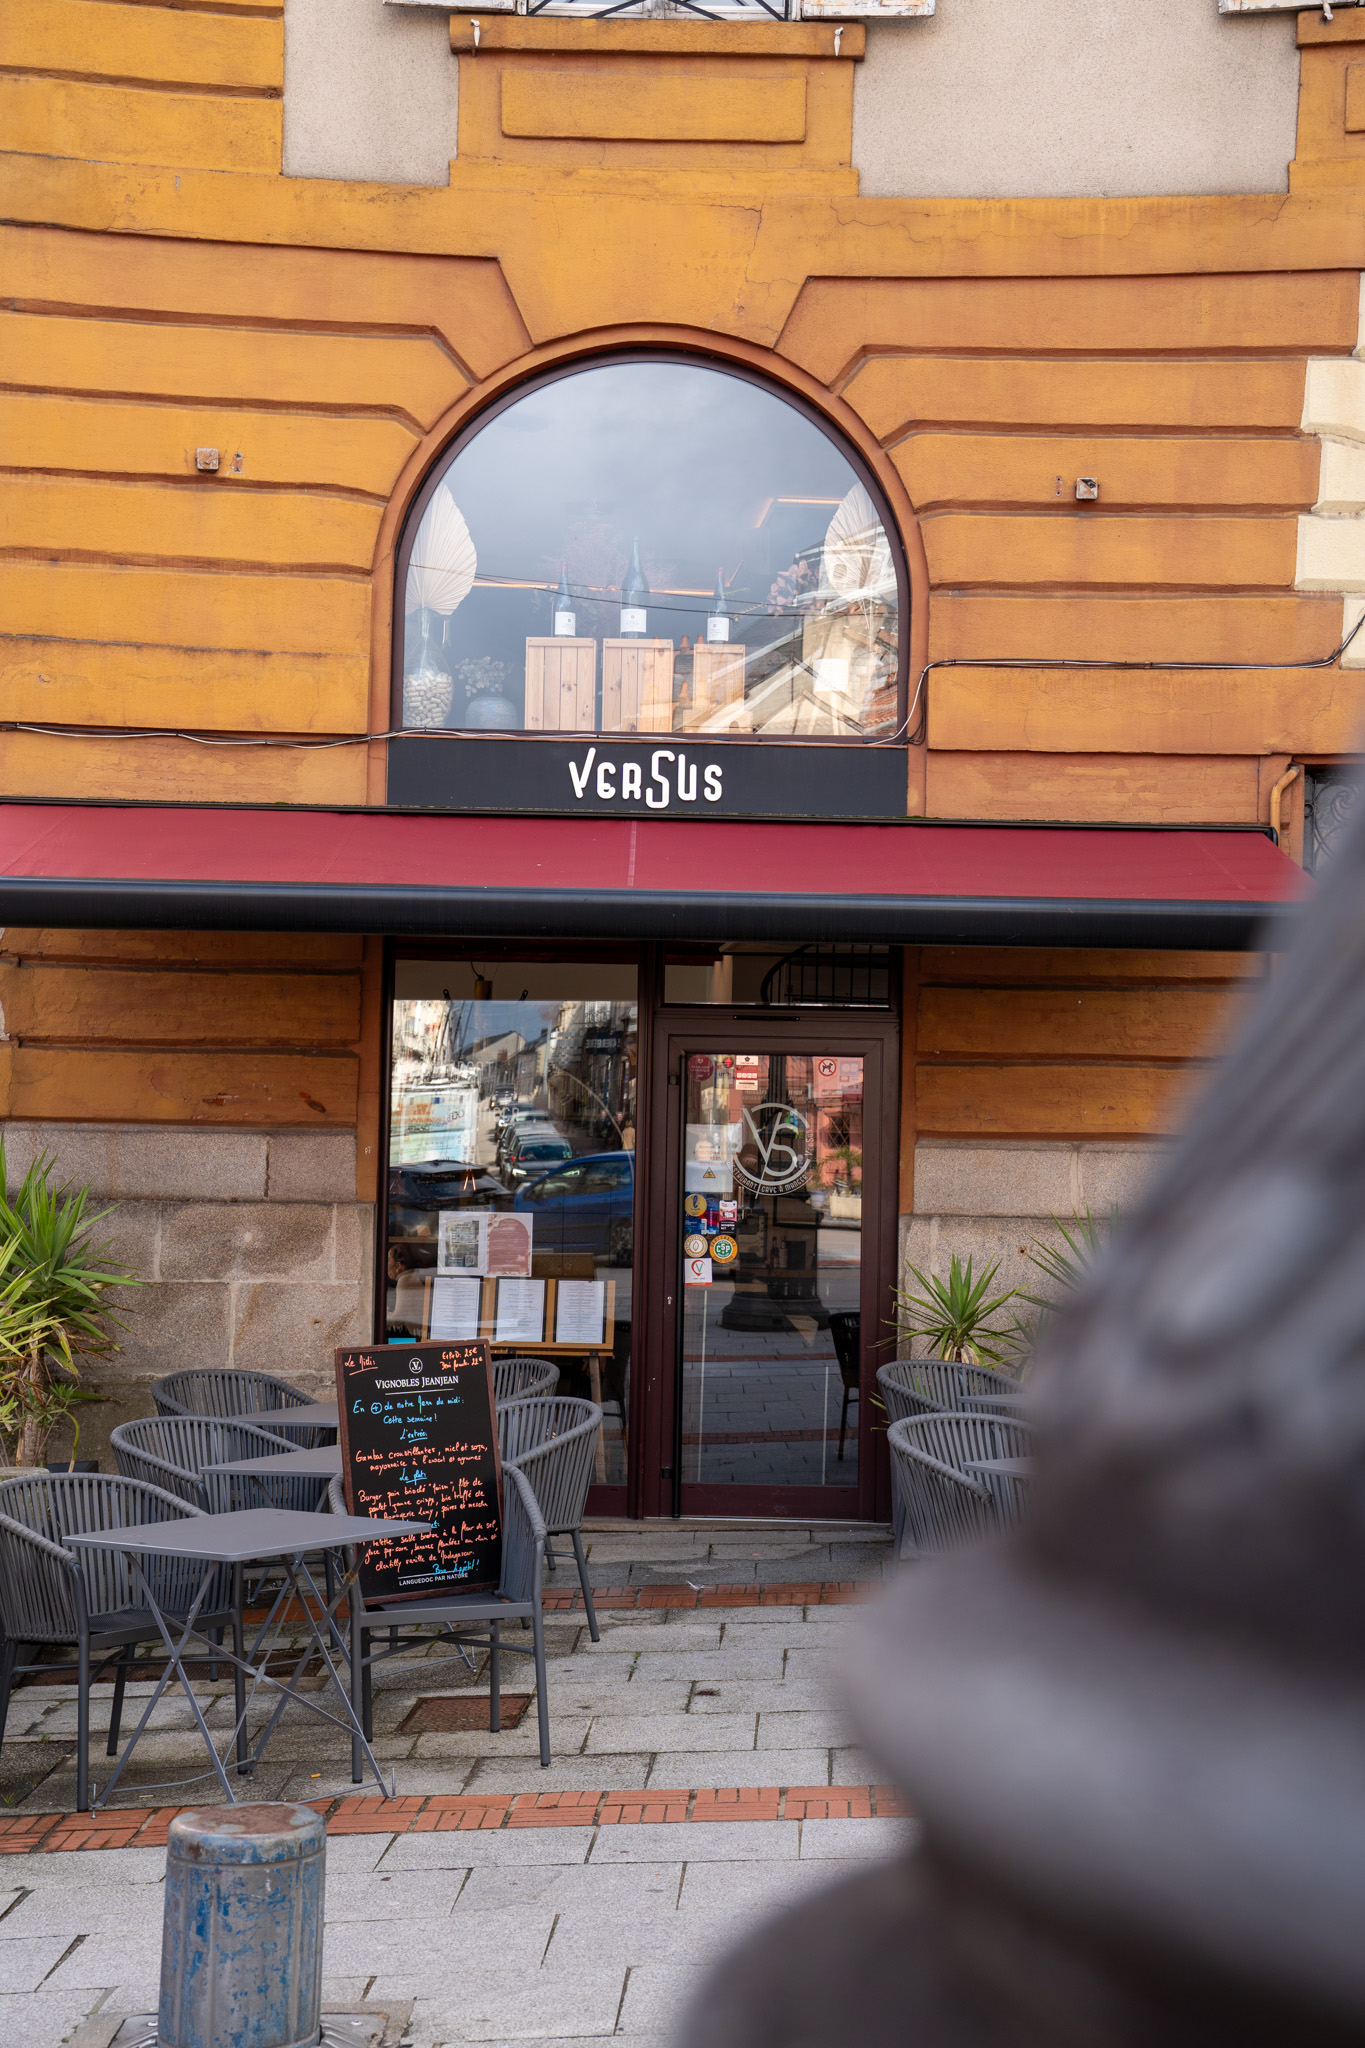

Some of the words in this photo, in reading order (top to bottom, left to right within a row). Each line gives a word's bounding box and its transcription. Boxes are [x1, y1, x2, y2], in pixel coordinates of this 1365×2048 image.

[568, 747, 723, 810] VERSUS
[716, 1244, 730, 1252] CSP
[375, 1376, 420, 1389] VIGNOBLES
[421, 1376, 459, 1388] JEANJEAN
[353, 1399, 365, 1414] En
[384, 1401, 393, 1410] de
[397, 1400, 414, 1408] notre
[436, 1397, 444, 1405] du
[384, 1415, 403, 1424] Cette
[356, 1449, 383, 1462] Gambas
[445, 1442, 459, 1452] miel
[460, 1442, 468, 1452] et
[370, 1462, 408, 1476] mayonnaise
[458, 1454, 482, 1465] agrumes
[399, 1468, 409, 1481] Le
[358, 1490, 382, 1505] Burger
[387, 1490, 400, 1506] pain
[473, 1477, 483, 1486] de
[432, 1563, 446, 1575] Bon
[399, 1576, 433, 1586] LANGUEDOC
